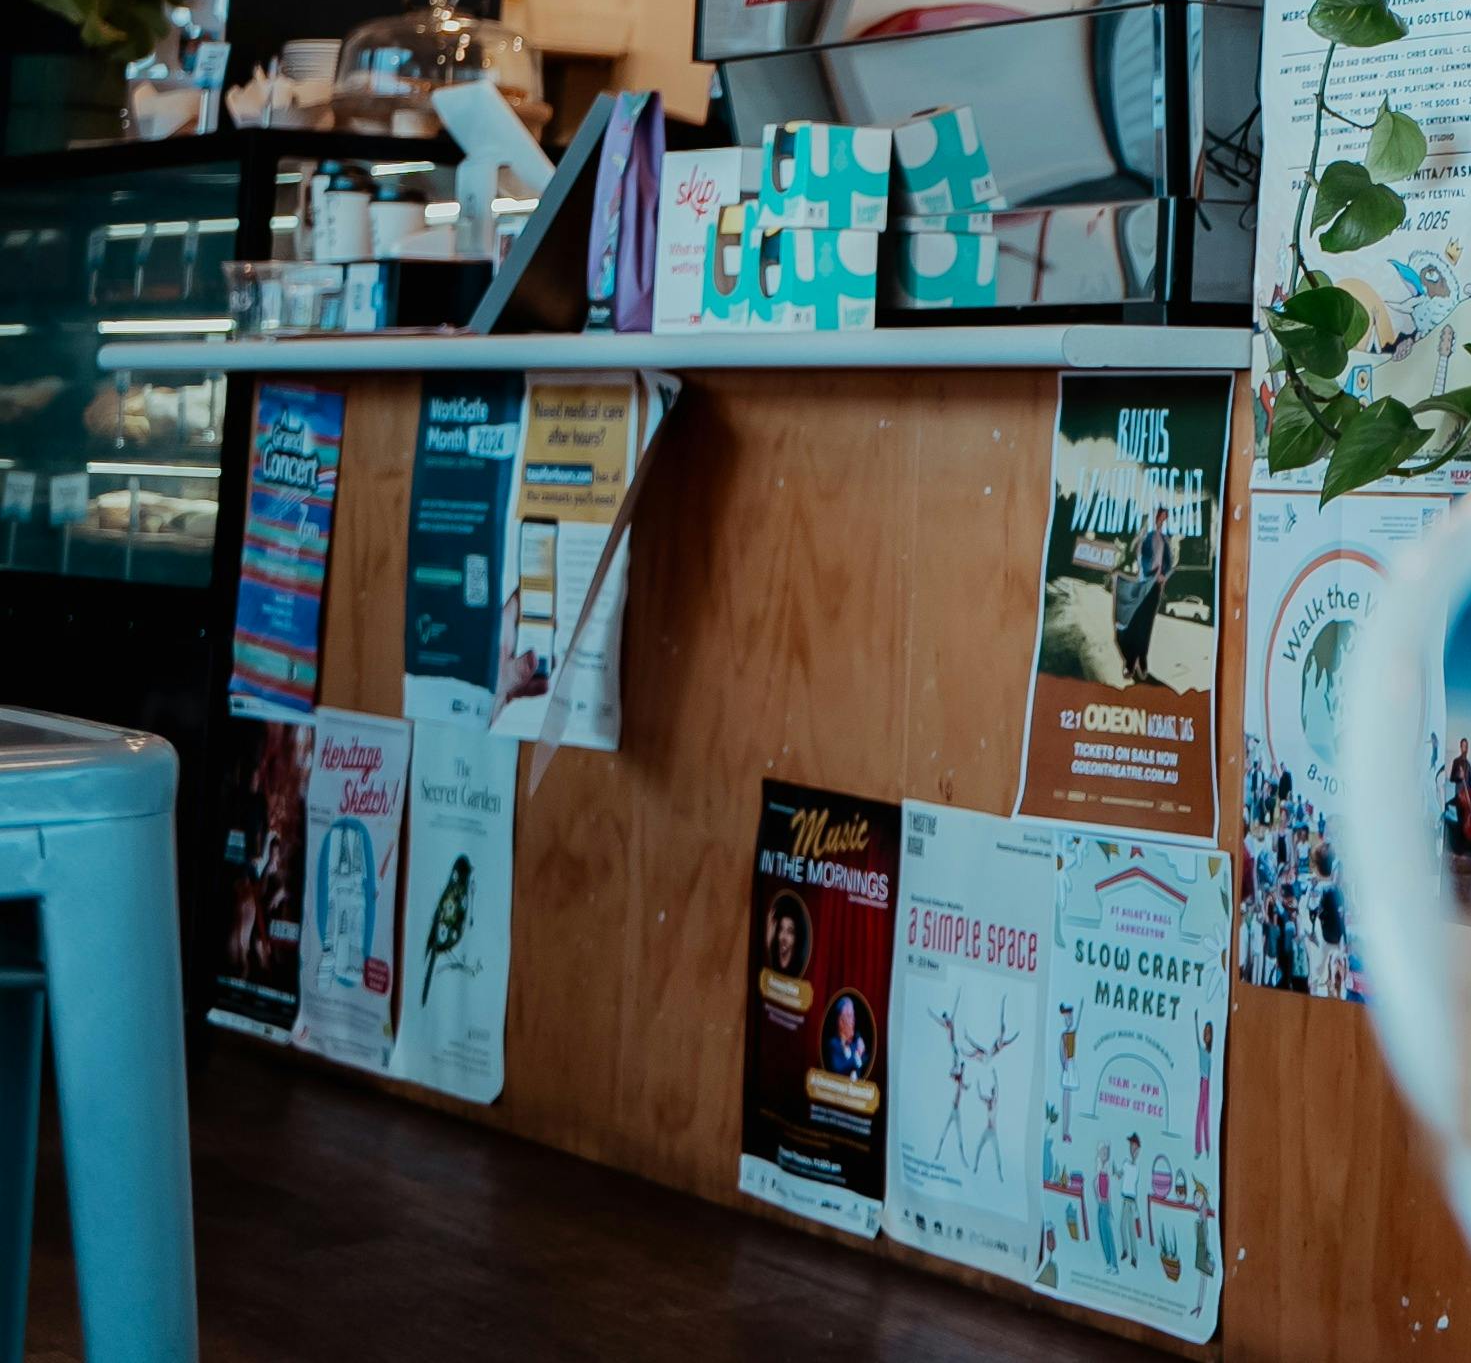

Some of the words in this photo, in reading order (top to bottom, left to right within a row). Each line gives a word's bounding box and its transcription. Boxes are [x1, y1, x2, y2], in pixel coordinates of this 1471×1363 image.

[1428, 189, 1465, 200] FESTIVAL
[1417, 210, 1451, 231] 2025
[430, 397, 489, 422] WorkSafe
[425, 425, 466, 452] Month
[1116, 408, 1169, 463] RUFUS
[263, 443, 319, 490] Concert
[1283, 598, 1325, 663] Walk
[1326, 583, 1360, 610] the
[1084, 704, 1146, 736] ODEON
[320, 736, 384, 783] Heritage
[1074, 742, 1114, 759] TICKETS
[339, 780, 400, 816] Sketch!
[791, 808, 871, 859] Music
[761, 849, 774, 874] IN
[776, 851, 805, 883] THE
[807, 858, 888, 901] MORNINGS
[1075, 939, 1130, 972] SLOW
[1138, 951, 1205, 988] CRAFT
[1095, 979, 1180, 1021] MARKET
